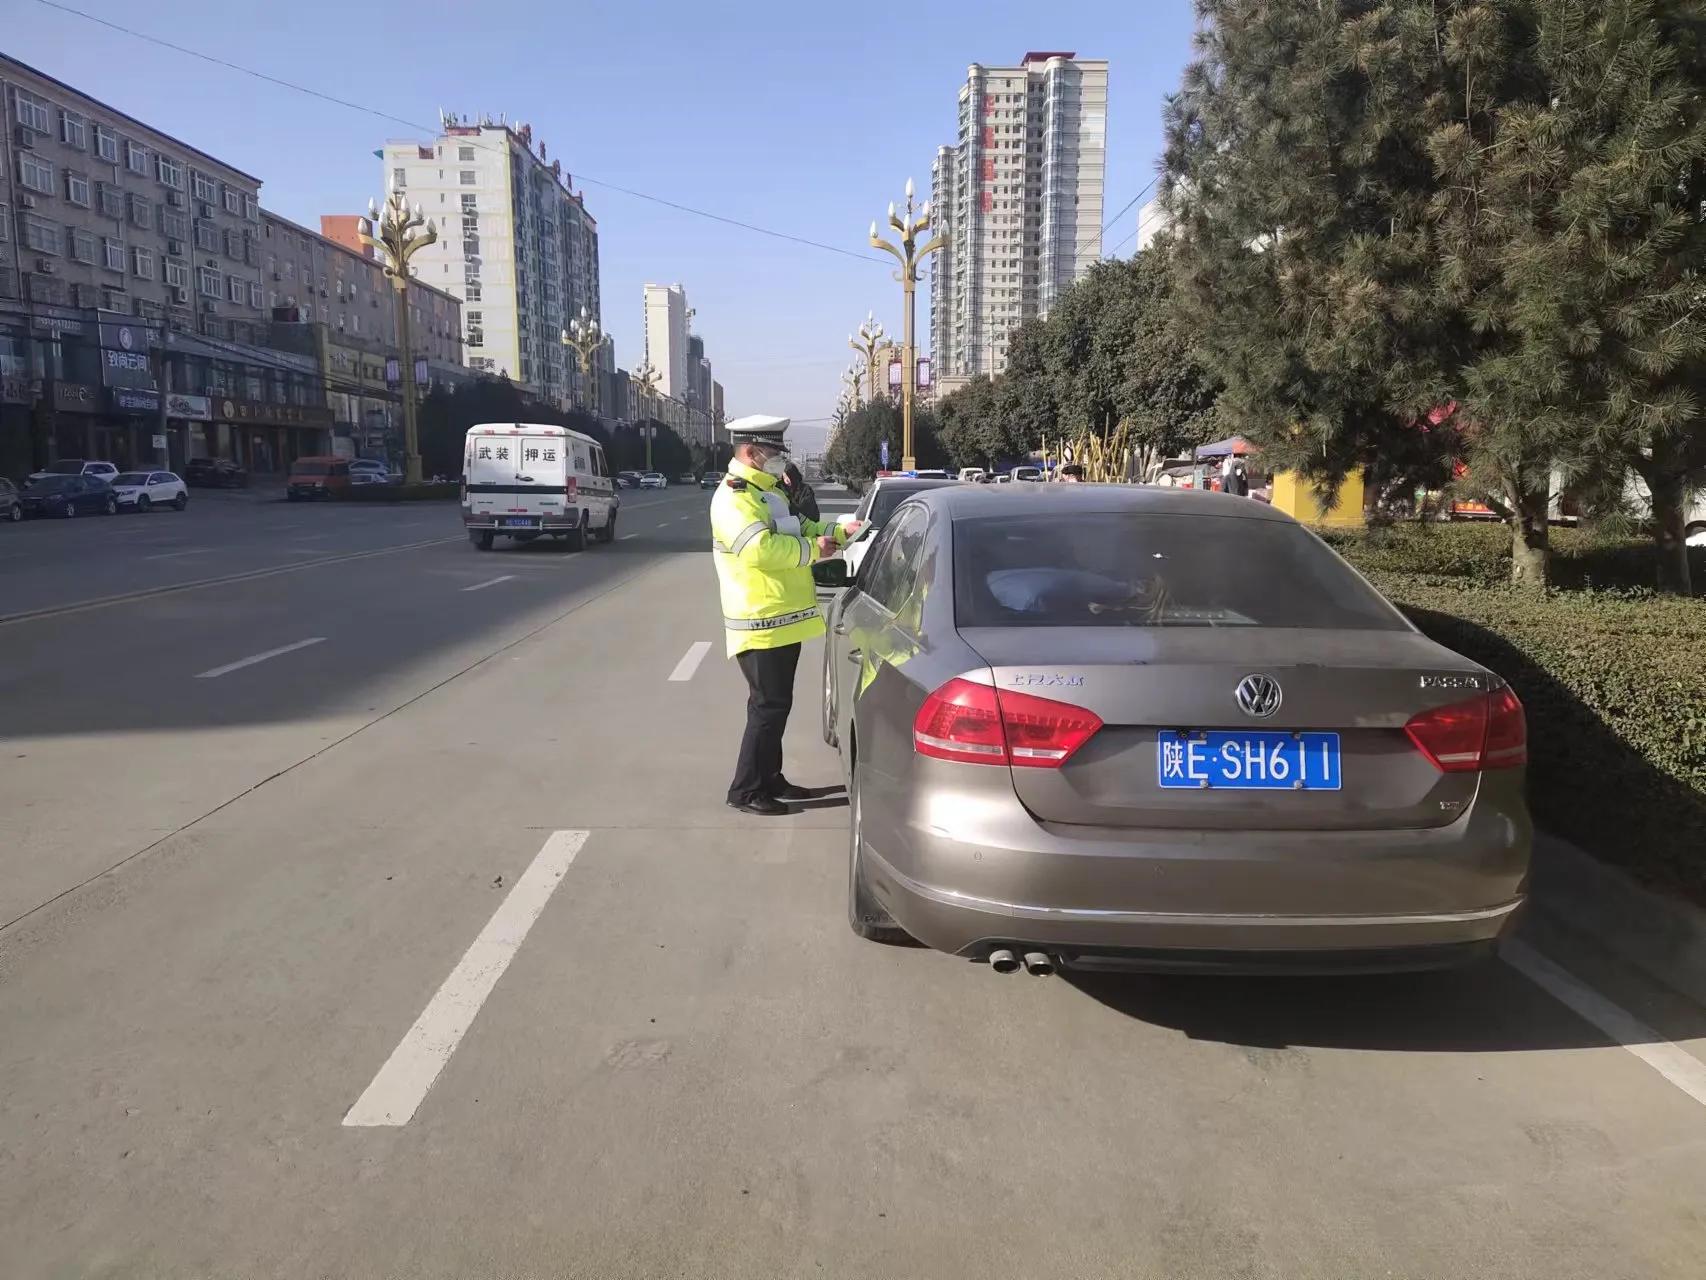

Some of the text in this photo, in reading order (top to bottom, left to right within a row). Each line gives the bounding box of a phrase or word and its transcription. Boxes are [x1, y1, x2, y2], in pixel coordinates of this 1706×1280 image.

[478, 446, 556, 462] 武装押运
[1163, 740, 1329, 781] 陕E·SH611
